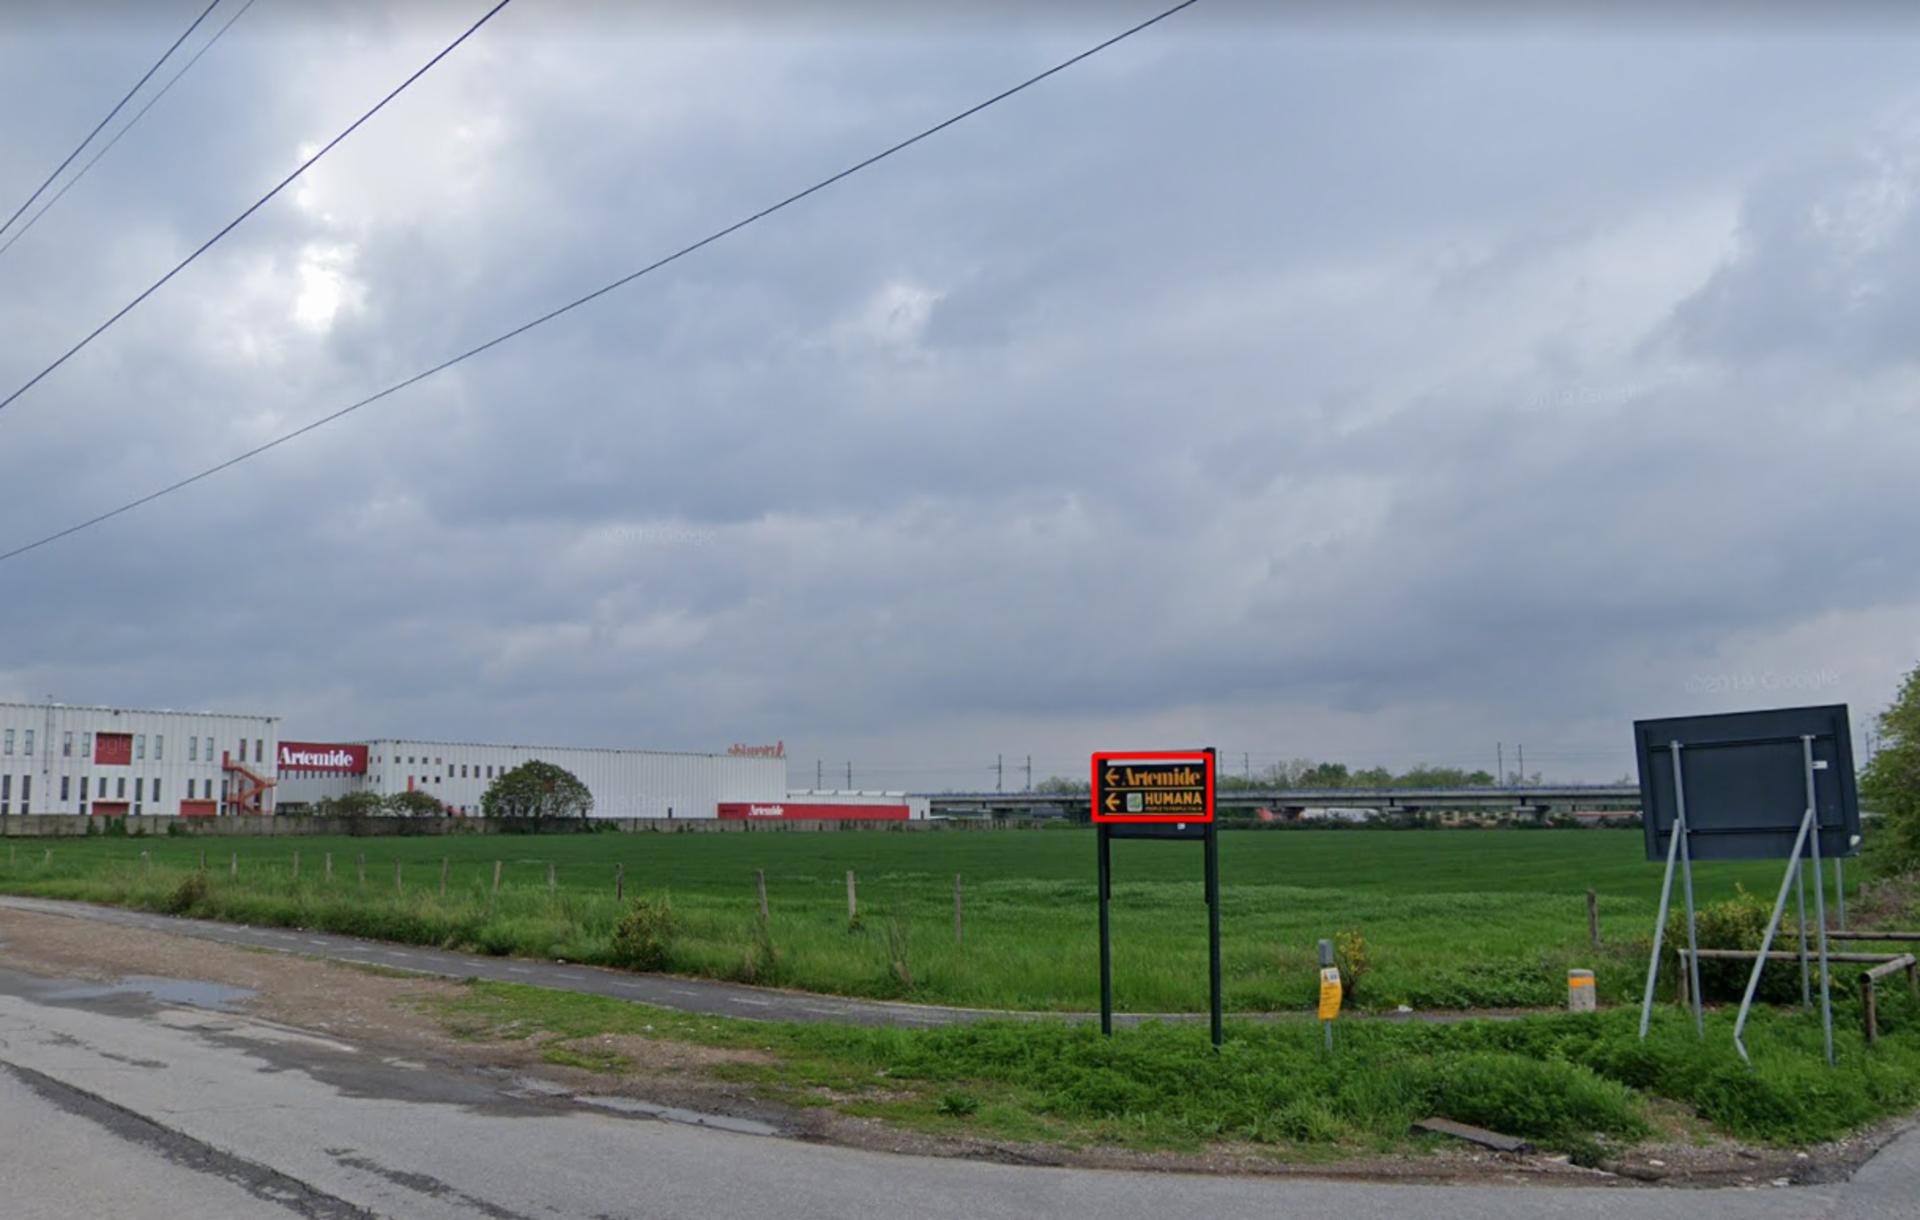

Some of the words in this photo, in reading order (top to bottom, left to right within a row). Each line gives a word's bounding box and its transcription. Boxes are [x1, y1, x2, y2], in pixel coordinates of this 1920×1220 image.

[278, 747, 354, 767] Artemide
[1121, 767, 1201, 786] Artemide
[1144, 792, 1203, 805] HUMANA
